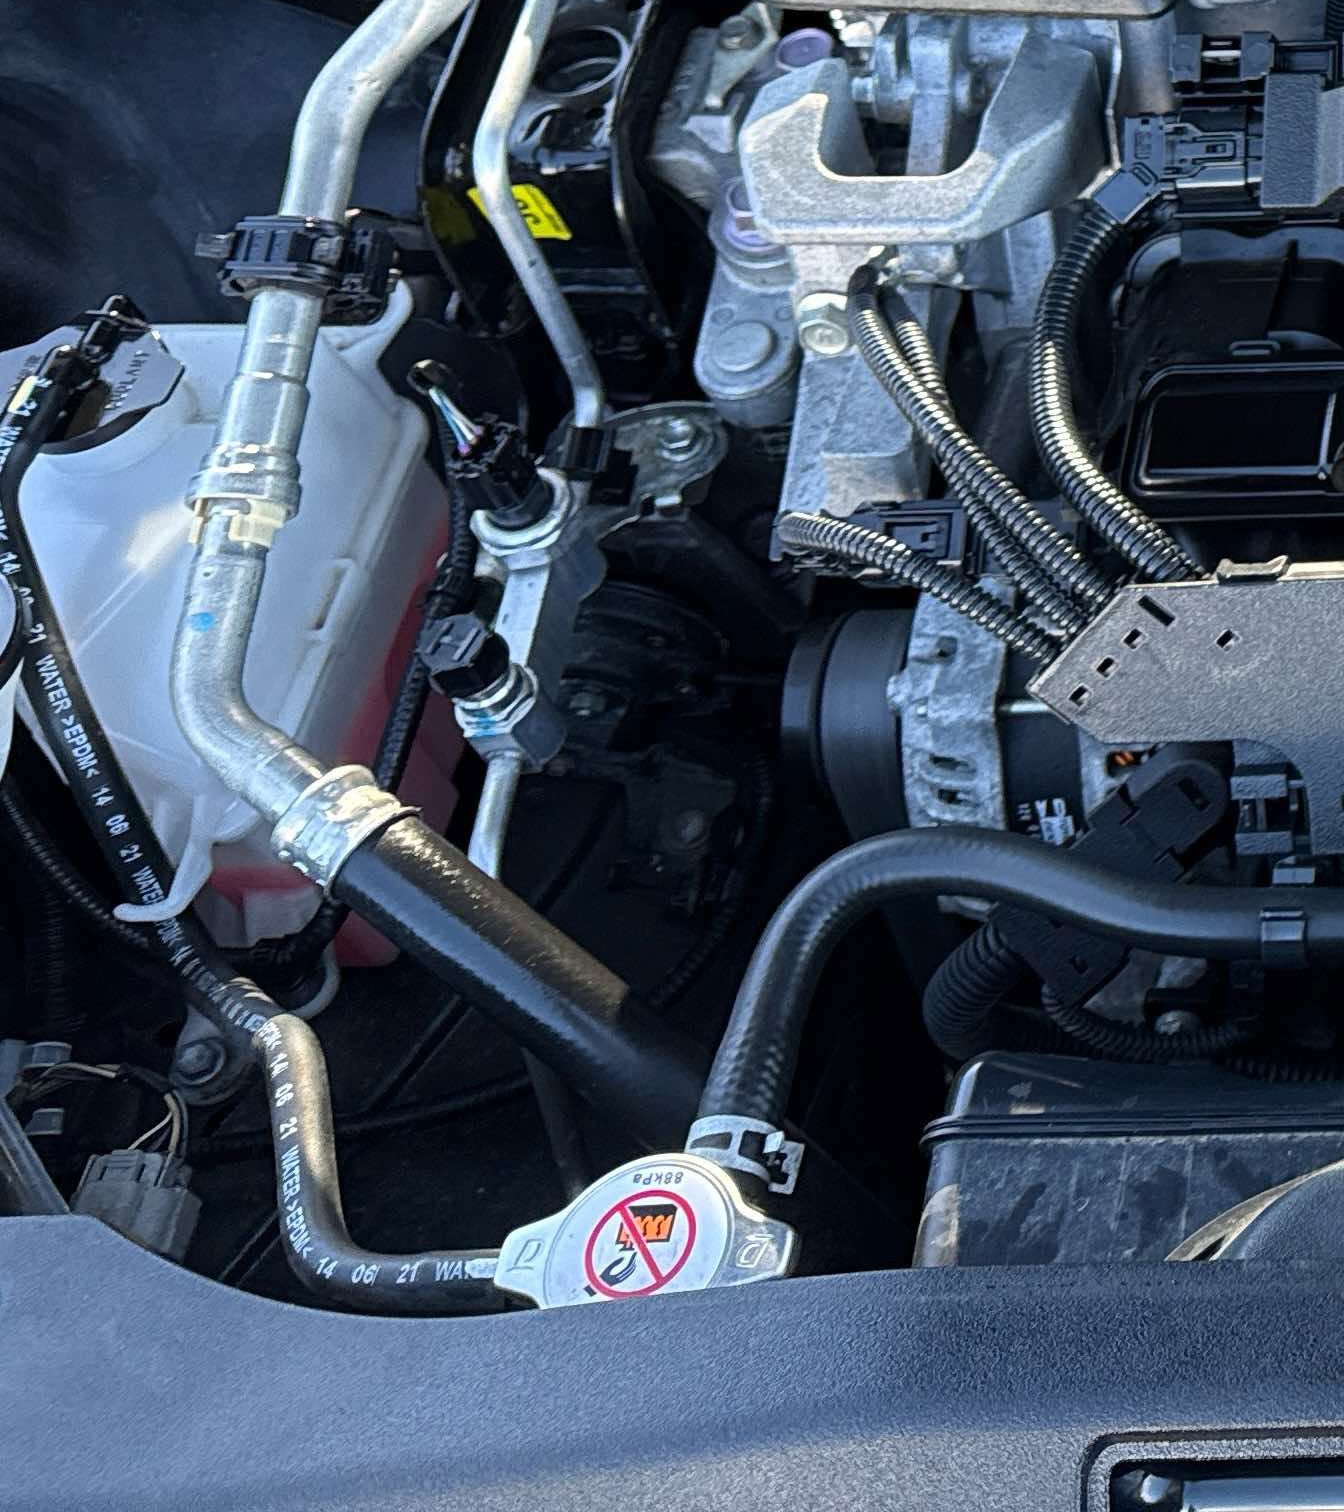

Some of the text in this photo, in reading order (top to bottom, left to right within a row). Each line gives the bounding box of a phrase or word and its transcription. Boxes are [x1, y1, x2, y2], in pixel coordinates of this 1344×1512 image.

[34, 654, 73, 716] WATER
[62, 713, 100, 779] >EPDM<
[91, 787, 114, 809] 14
[120, 843, 144, 864] 21
[279, 1116, 298, 1141] 21
[279, 1144, 301, 1201] WATER
[633, 1171, 684, 1186] 88kPa
[315, 1256, 339, 1280] 14
[396, 1259, 424, 1285] 21
